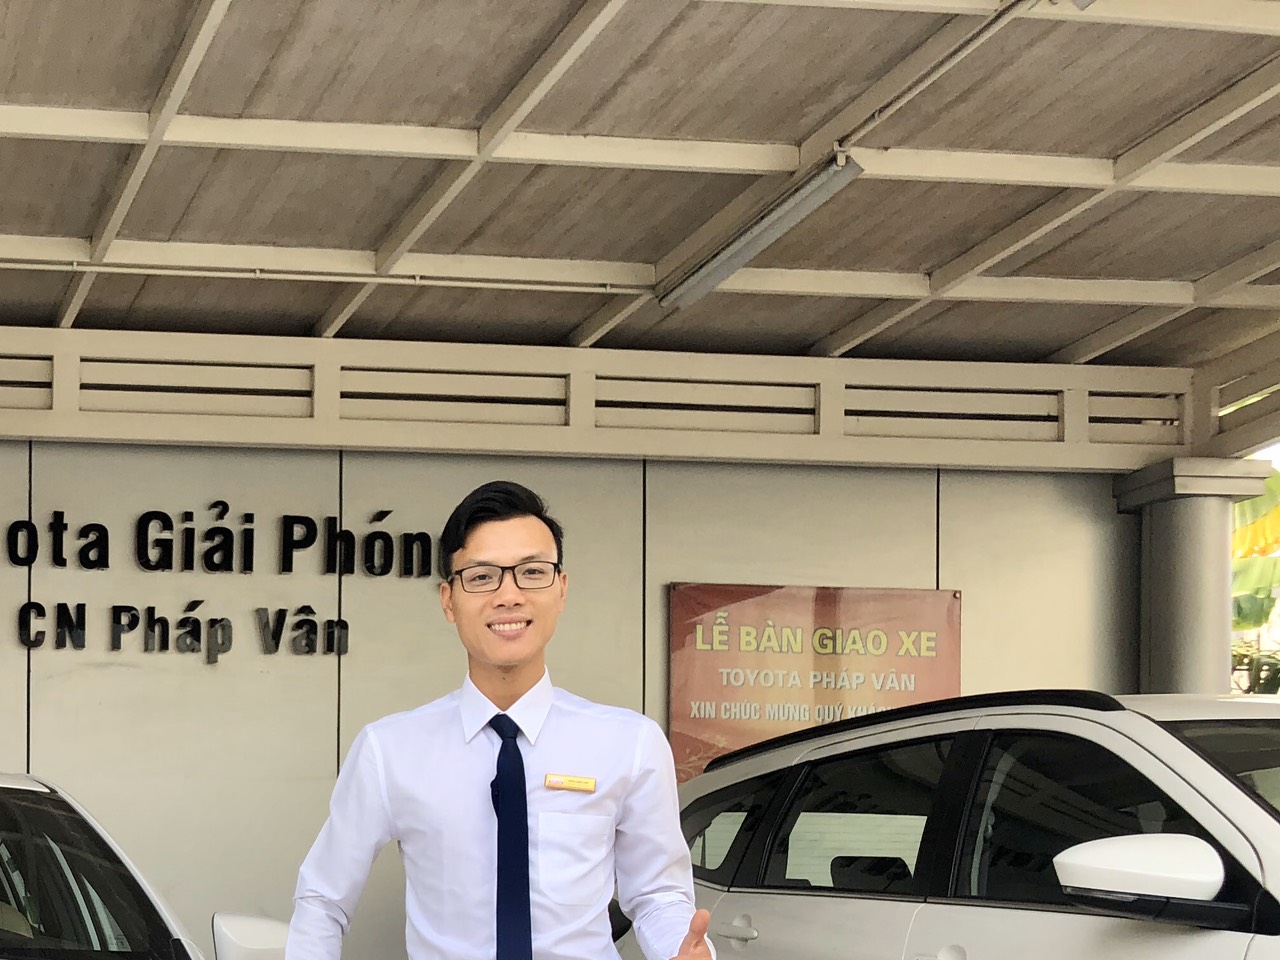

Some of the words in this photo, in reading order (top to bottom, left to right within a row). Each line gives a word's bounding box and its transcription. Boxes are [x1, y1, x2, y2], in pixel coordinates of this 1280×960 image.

[136, 500, 255, 575] Giải
[280, 509, 442, 577] Phón
[19, 601, 87, 650] CN
[108, 600, 233, 664] Pháp
[253, 604, 350, 656] Vân
[694, 611, 730, 651] LỄ
[739, 621, 803, 654] BÀN
[811, 627, 888, 657] GIAO
[897, 630, 938, 658] XE
[719, 668, 802, 689] TOYOTA
[809, 667, 865, 690] PHÁP
[871, 669, 916, 692] VÂN
[690, 701, 716, 719] XIN
[721, 699, 760, 720] CHÚC
[815, 702, 844, 723] QUÝ
